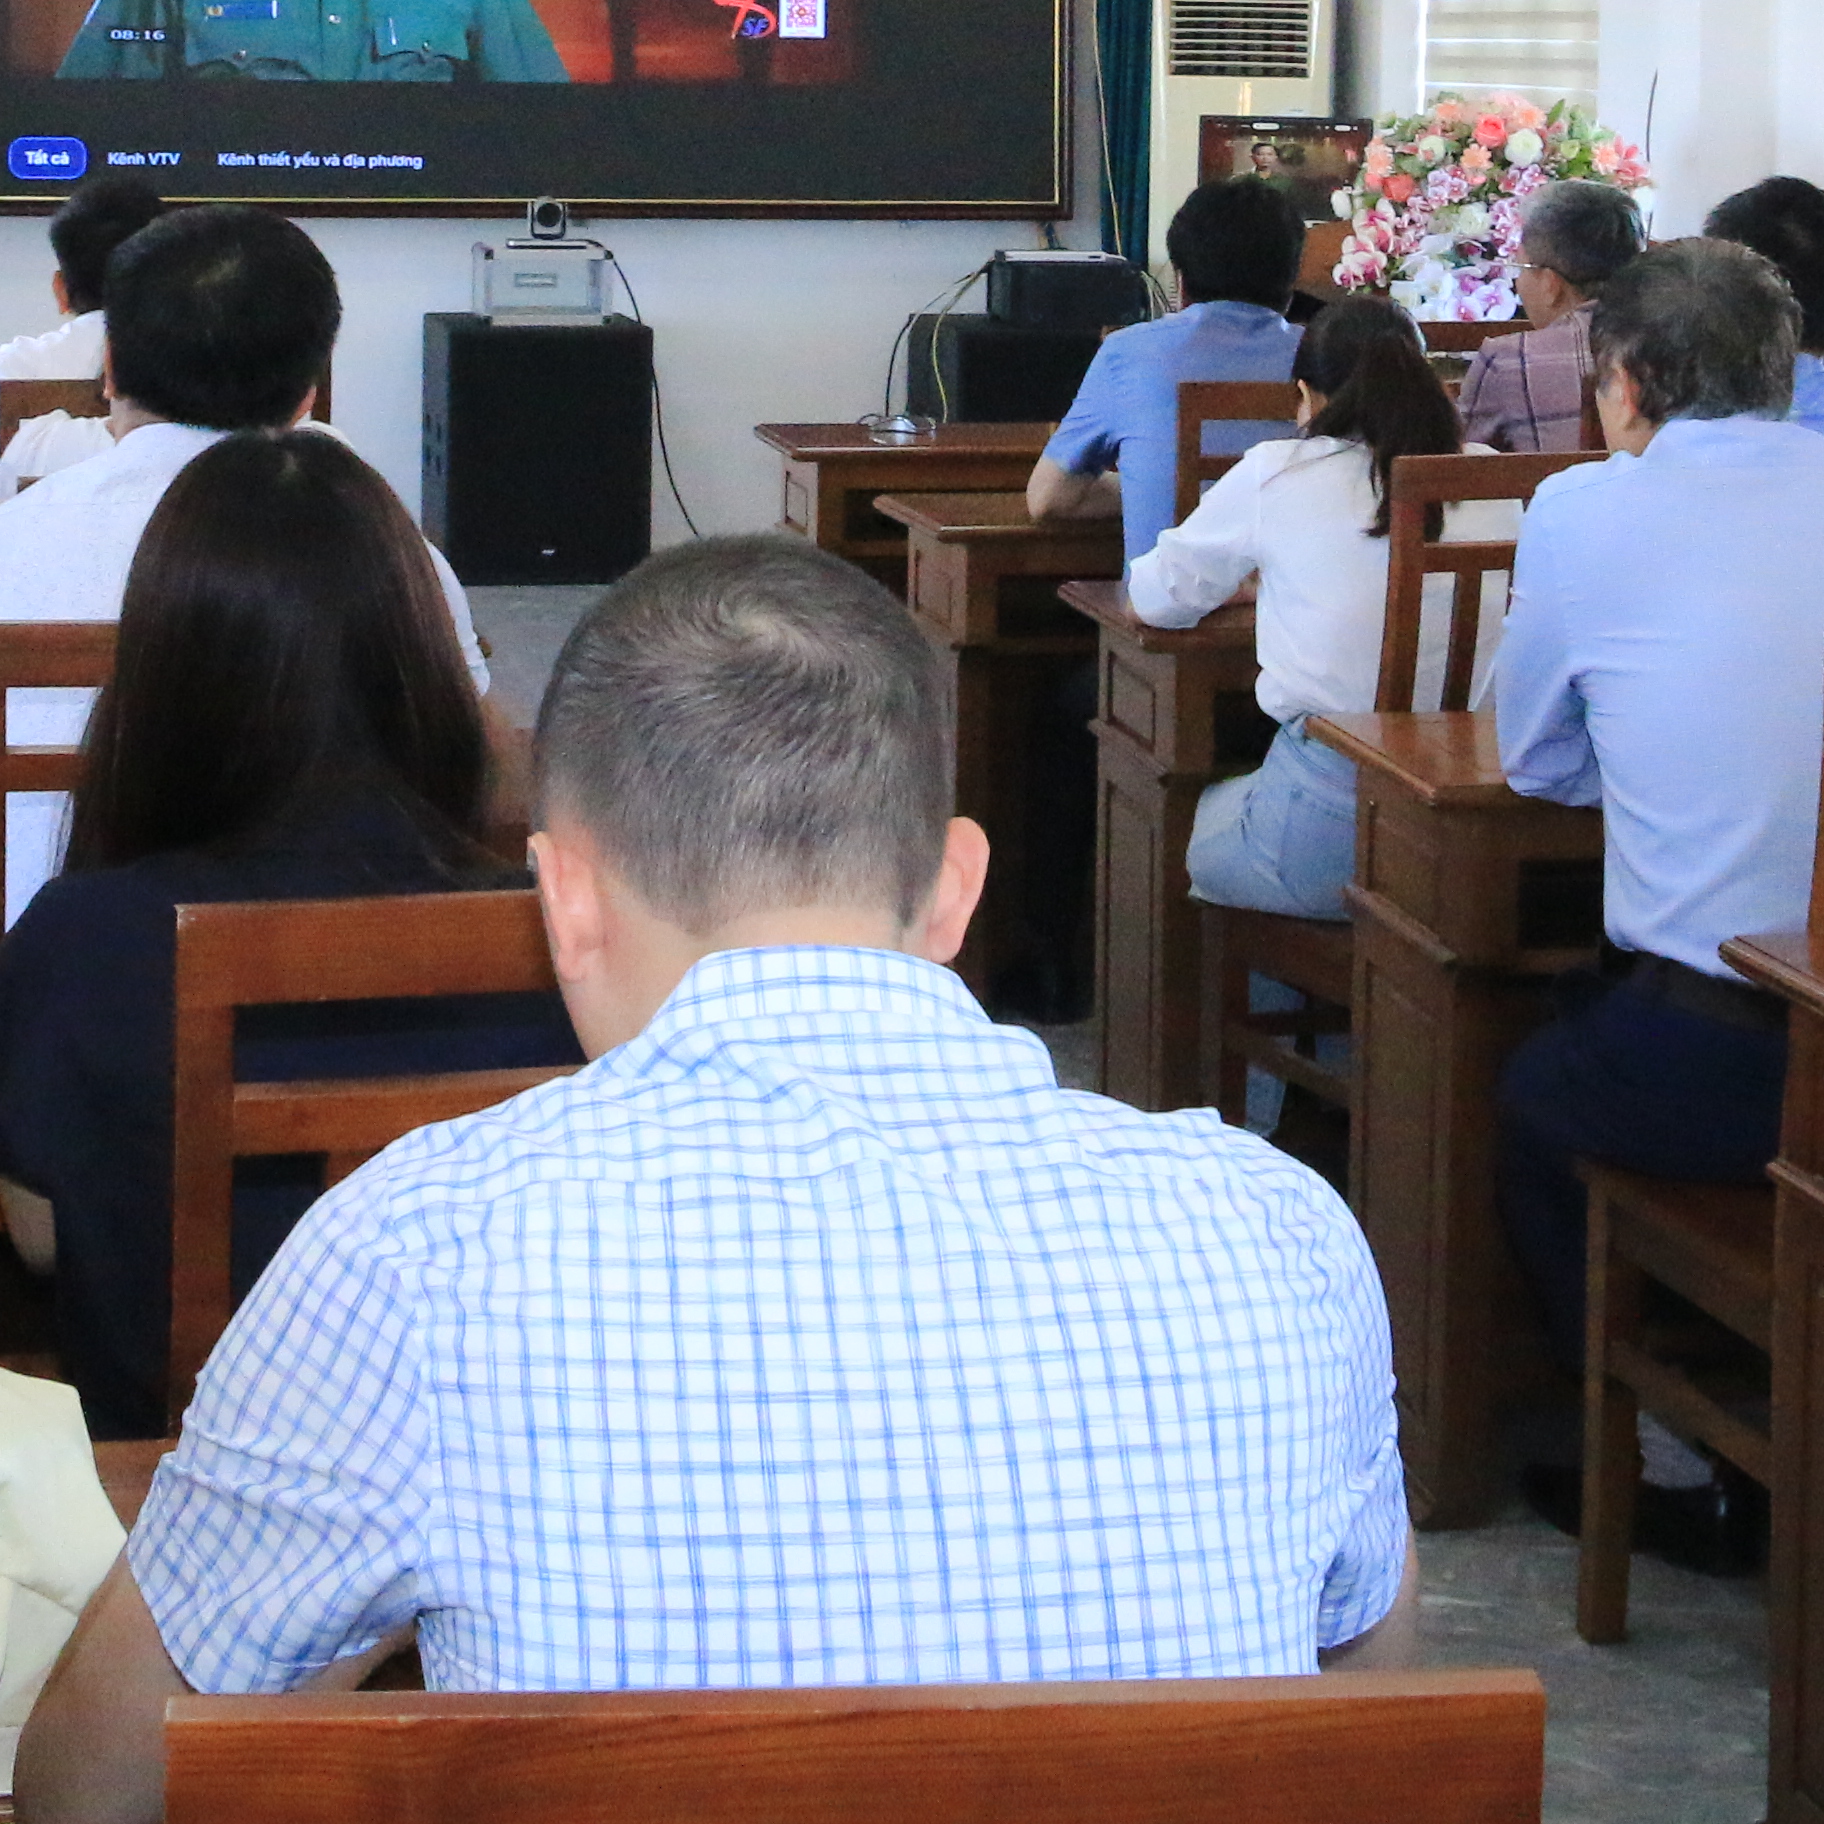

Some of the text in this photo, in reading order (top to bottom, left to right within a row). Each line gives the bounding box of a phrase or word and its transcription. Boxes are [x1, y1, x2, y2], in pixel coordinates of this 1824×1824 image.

[110, 29, 166, 41] 08:16
[25, 149, 70, 165] Tất cả
[107, 151, 180, 165] Kênh VTV
[217, 152, 255, 166] Kênh
[323, 153, 340, 166] và
[343, 154, 365, 169] địa
[368, 155, 423, 170] phương
